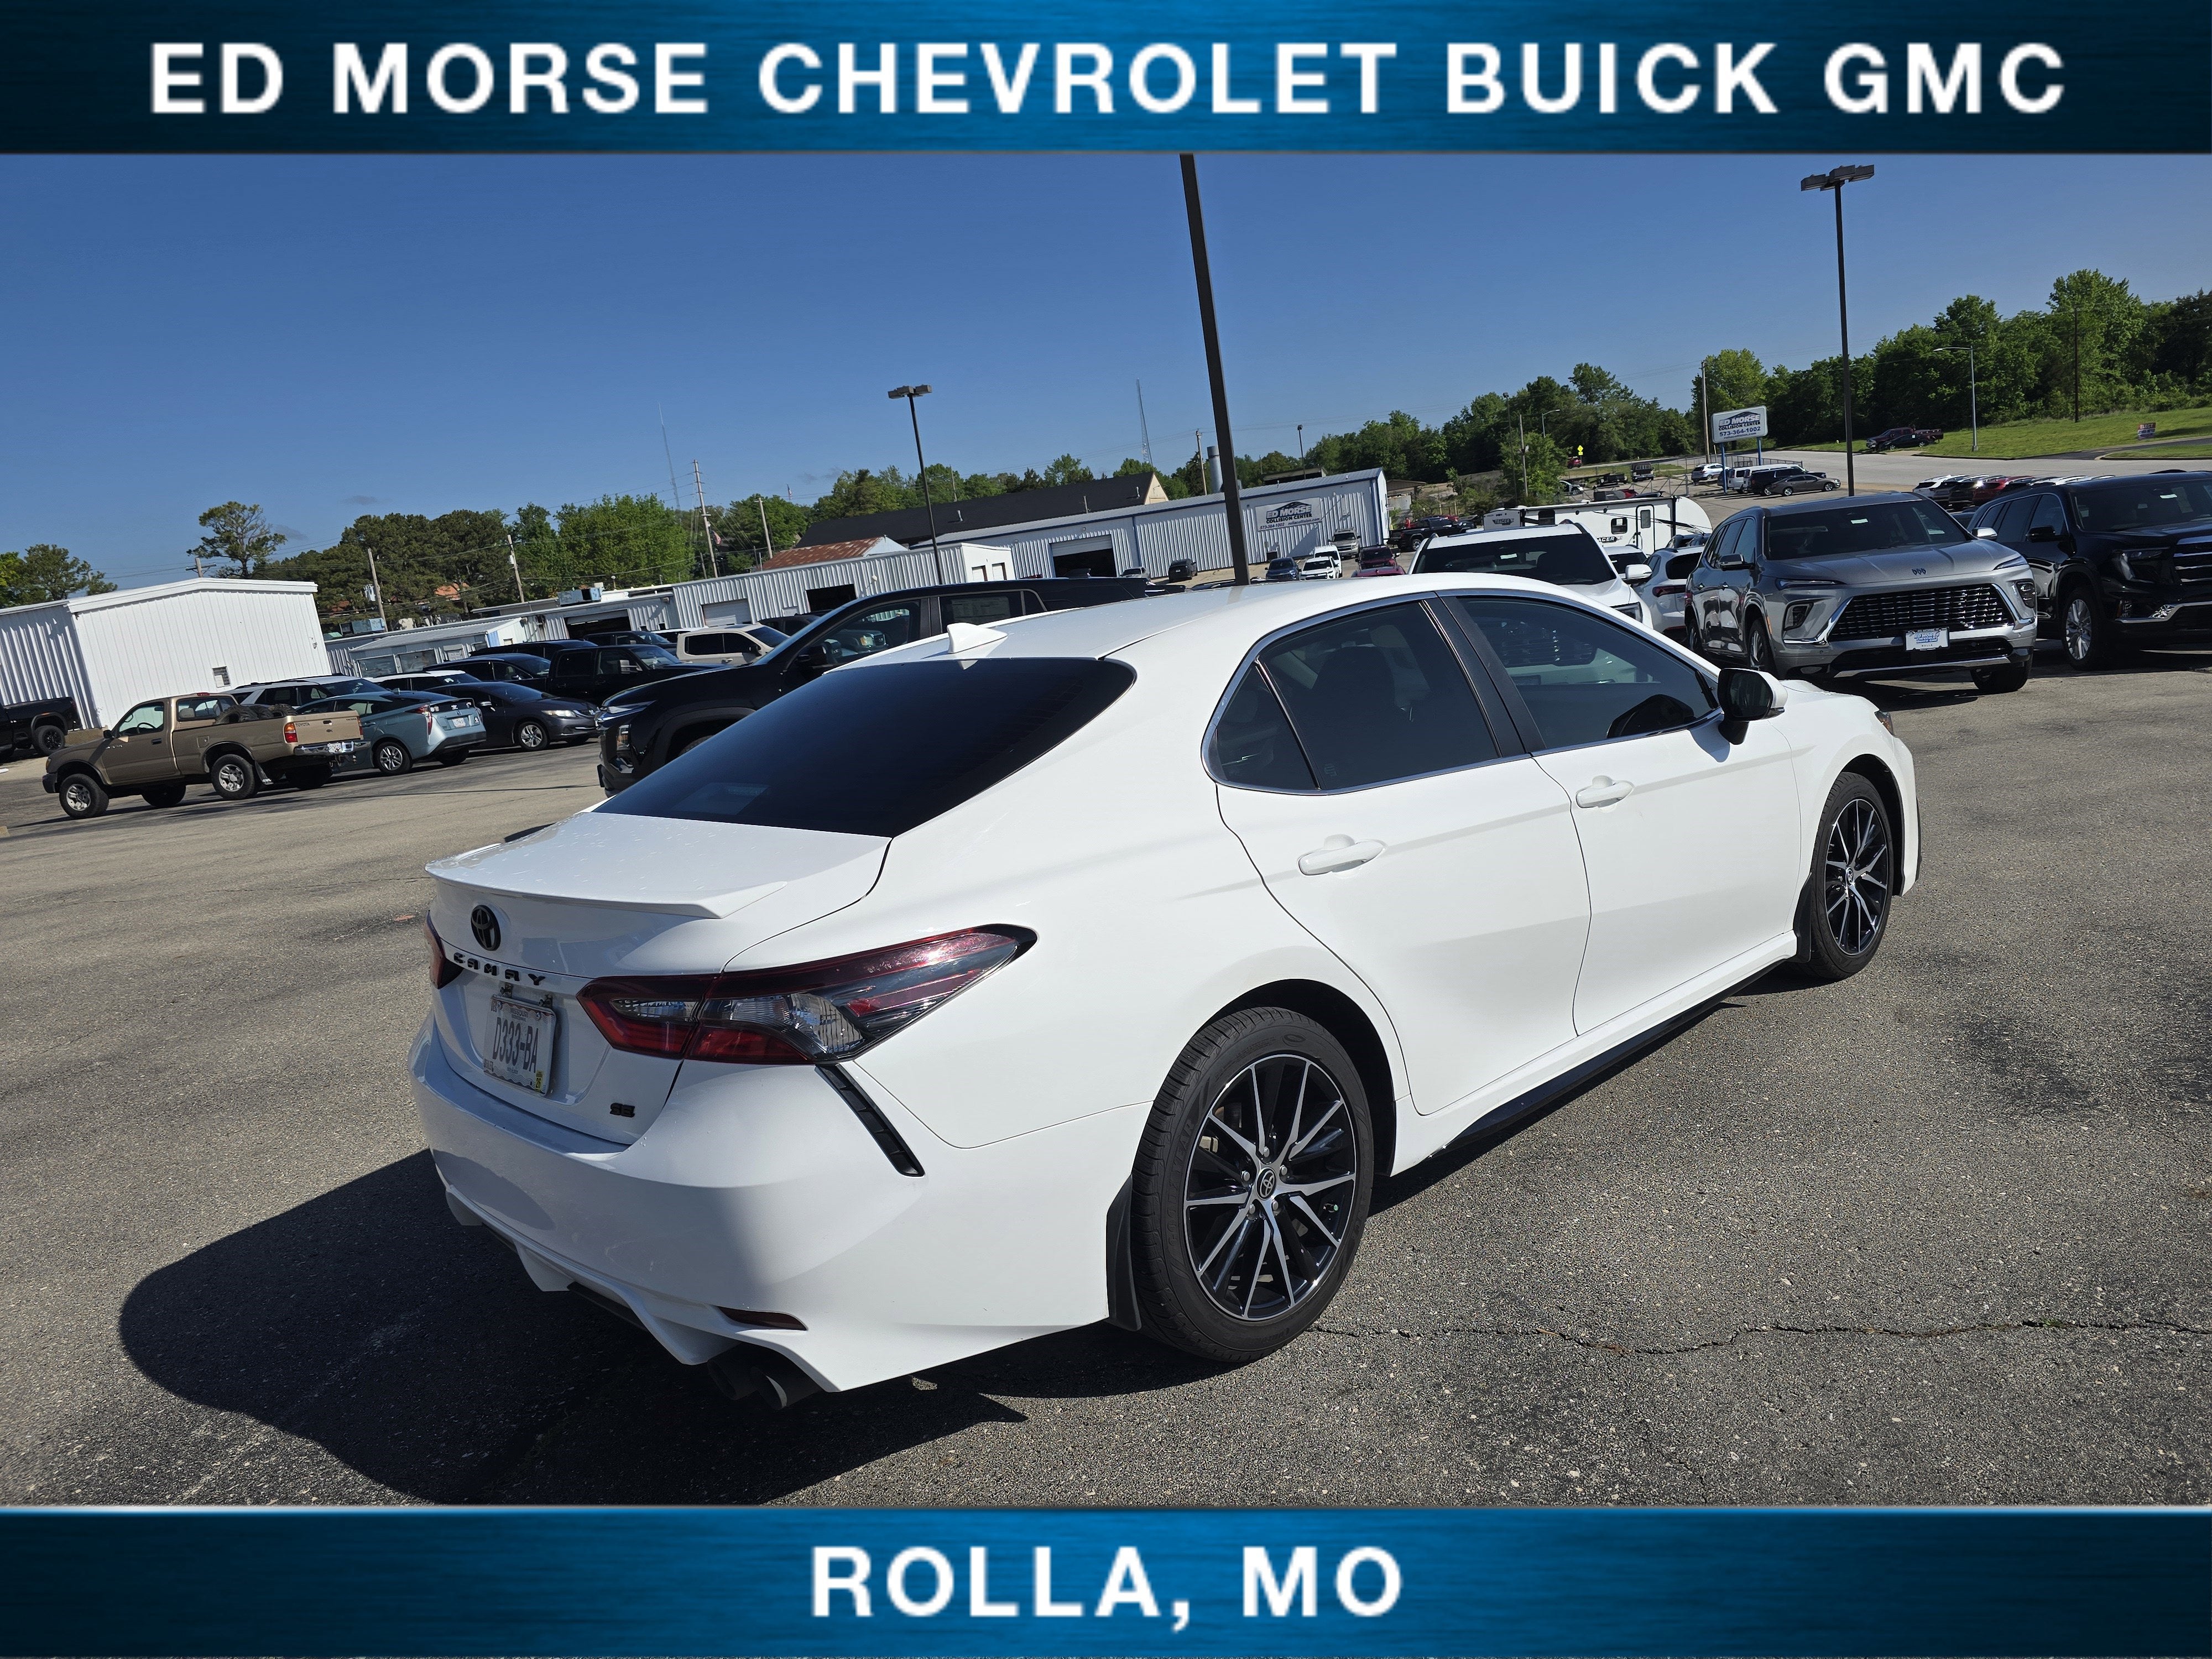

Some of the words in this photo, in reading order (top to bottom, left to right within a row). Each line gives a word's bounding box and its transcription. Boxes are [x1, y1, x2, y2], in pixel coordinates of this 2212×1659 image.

[1731, 414, 1760, 425] MORSE
[1720, 426, 1761, 436] 573-364-1002
[1280, 505, 1311, 517] MORSE
[453, 952, 546, 986] CAMRY
[492, 1016, 539, 1073] D333-BA
[610, 1102, 635, 1118] SE
